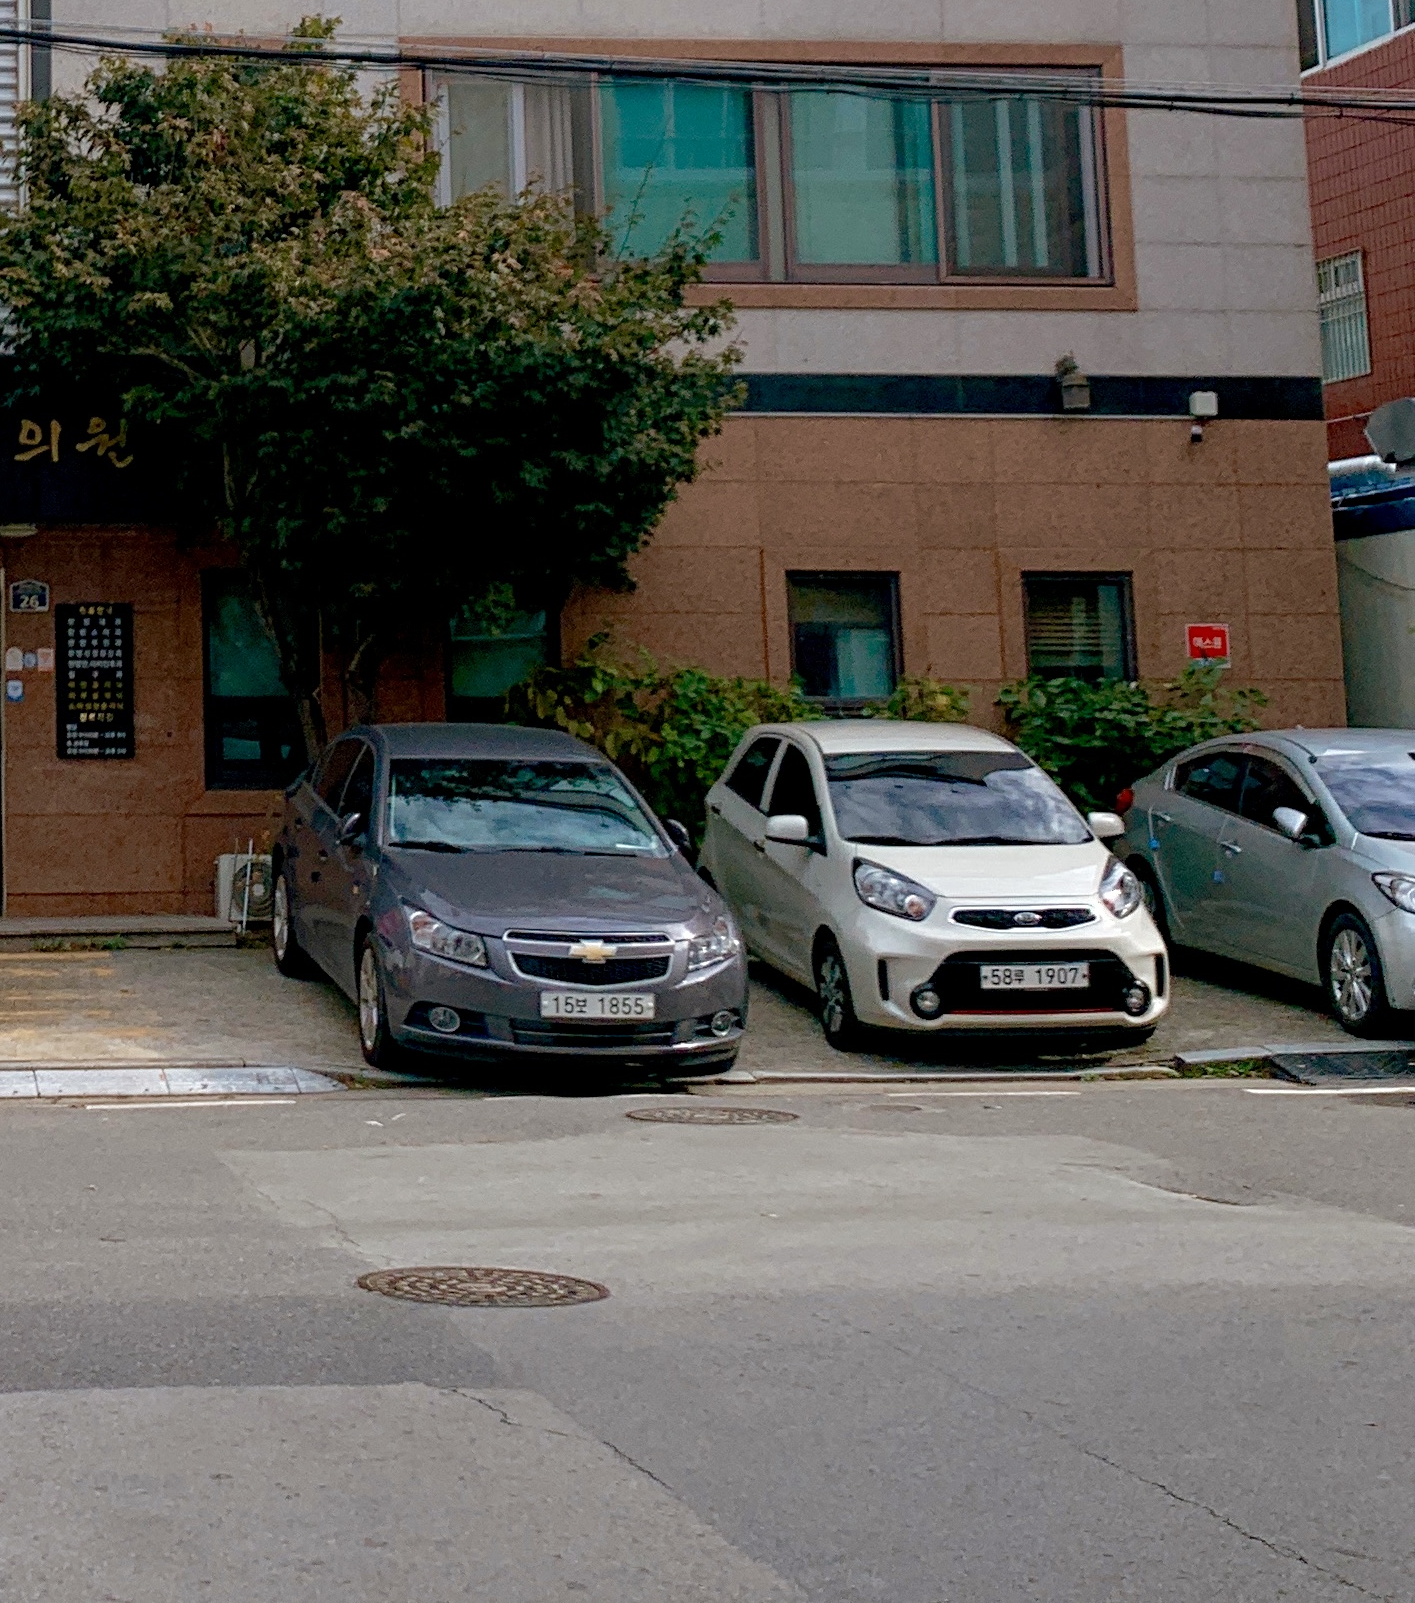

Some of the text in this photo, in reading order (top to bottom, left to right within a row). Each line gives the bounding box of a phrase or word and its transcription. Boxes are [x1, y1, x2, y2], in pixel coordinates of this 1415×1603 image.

[19, 594, 40, 609] 26
[991, 967, 1079, 985] 58루 1907
[598, 997, 644, 1015] 1855
